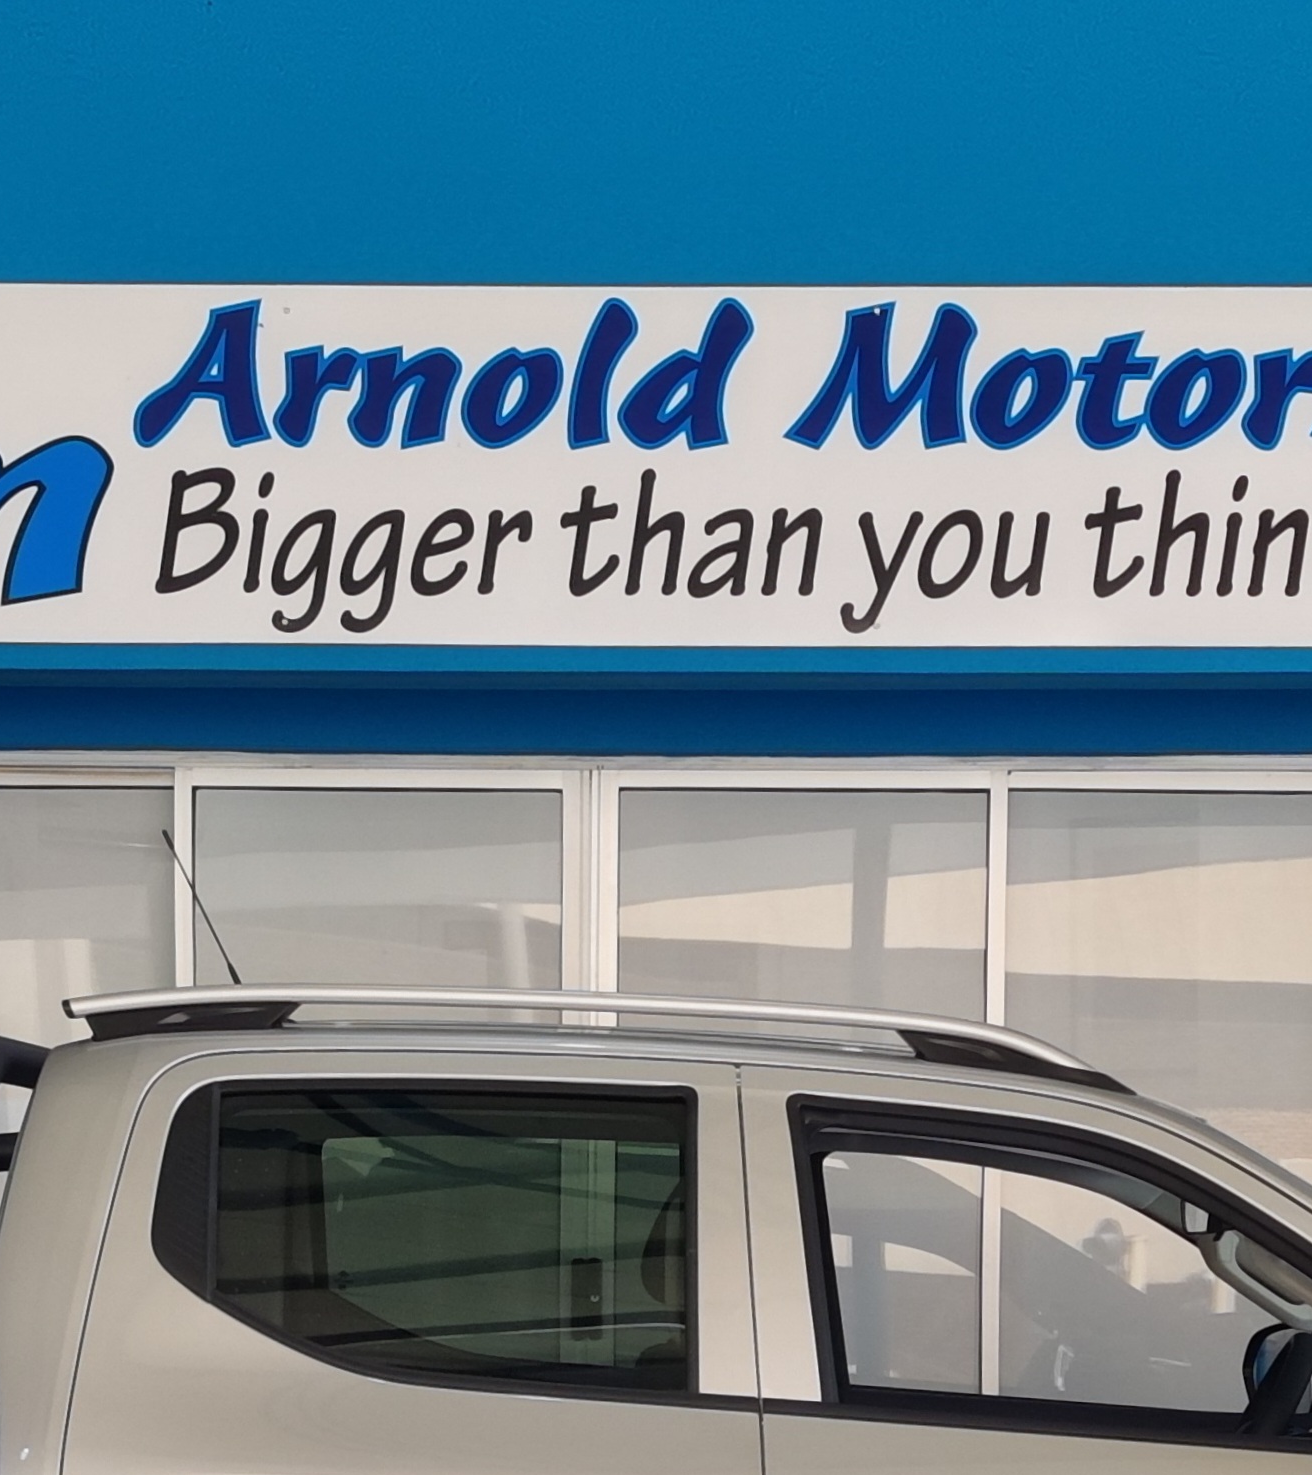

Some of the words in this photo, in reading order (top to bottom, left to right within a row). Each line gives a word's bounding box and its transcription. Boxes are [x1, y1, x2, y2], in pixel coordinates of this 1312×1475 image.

[131, 297, 757, 452] Arnold
[151, 468, 541, 634] Bigger
[560, 467, 822, 600] than
[836, 499, 1051, 634] you
